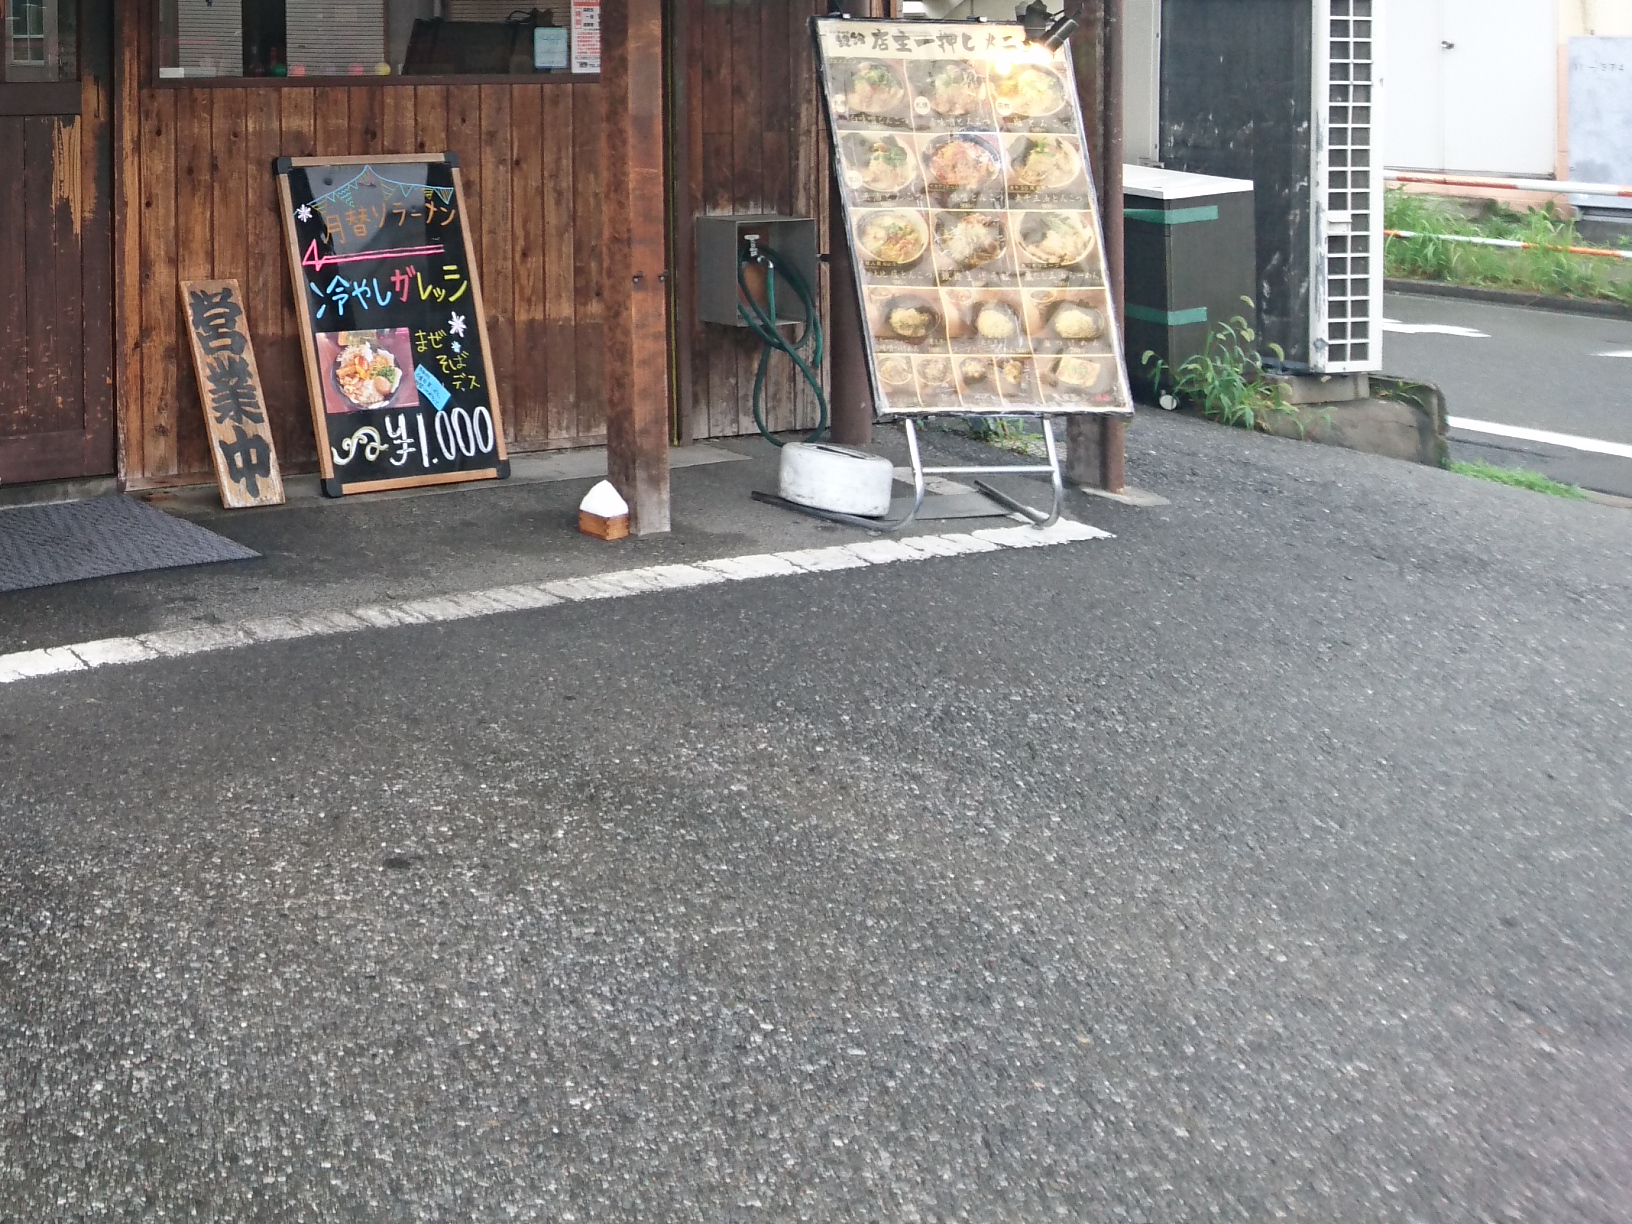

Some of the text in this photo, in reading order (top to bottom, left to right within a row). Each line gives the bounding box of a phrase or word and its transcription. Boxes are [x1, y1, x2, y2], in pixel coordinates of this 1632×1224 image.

[871, 28, 976, 53] 店主一押し
[323, 201, 457, 246] 月替りラーメン
[189, 287, 271, 499] 営業中
